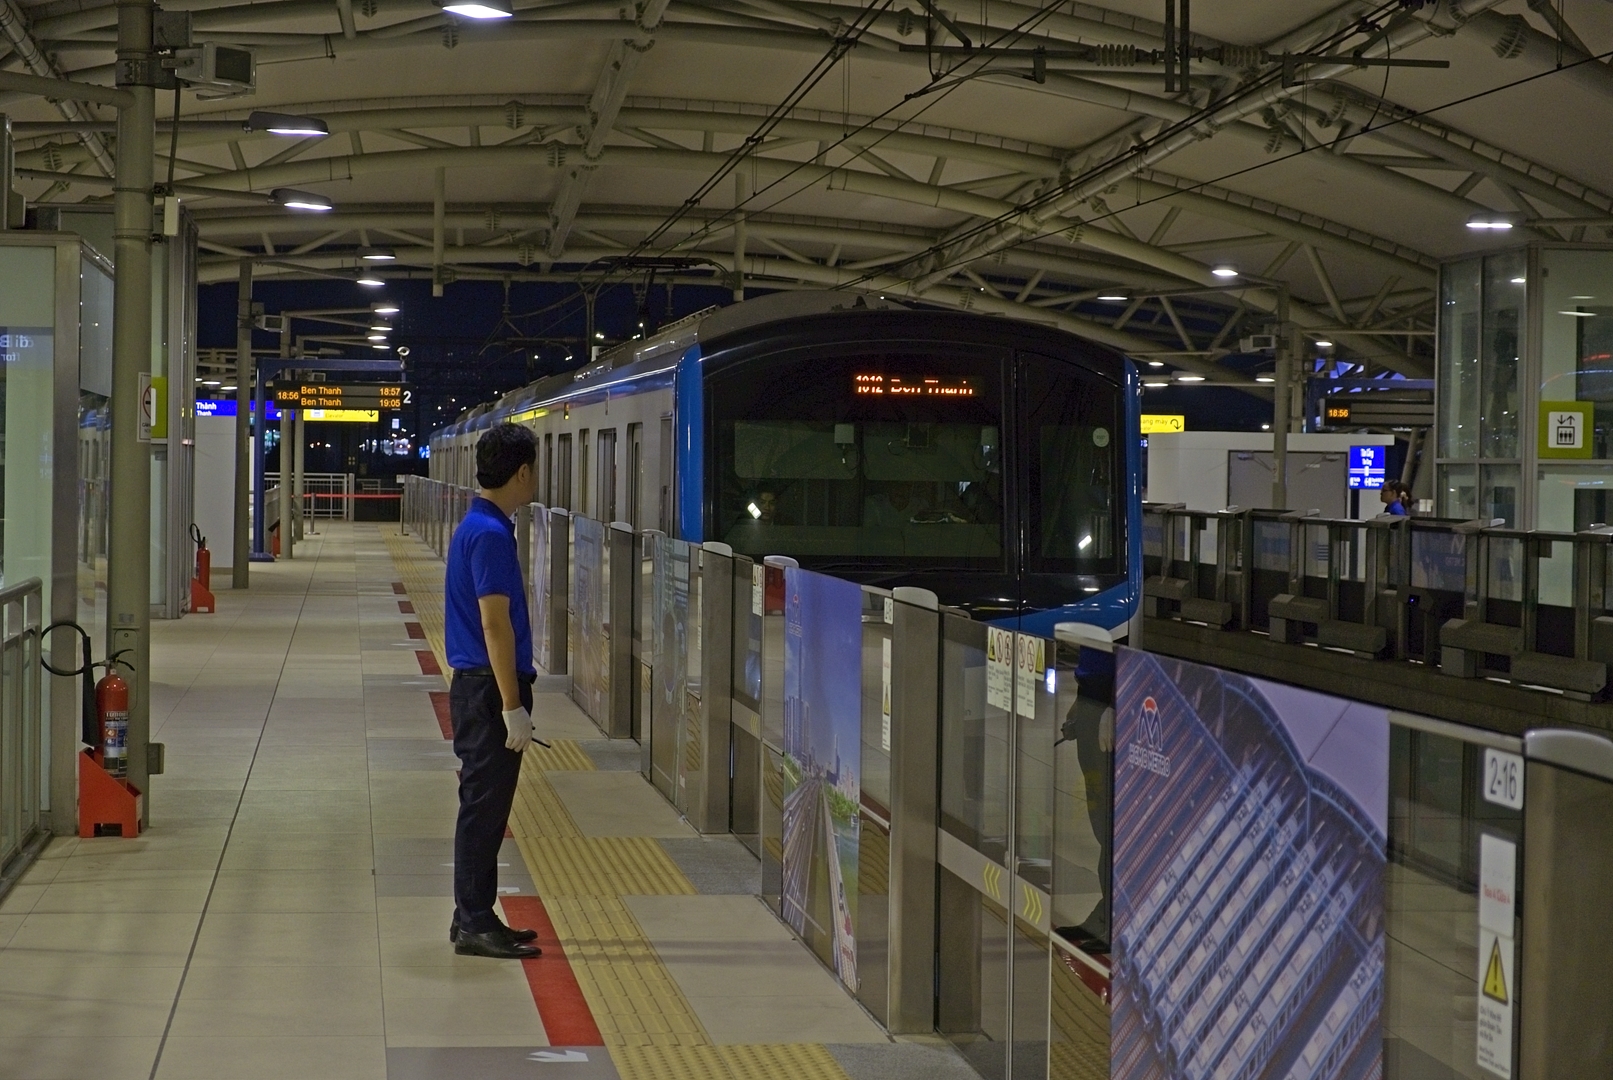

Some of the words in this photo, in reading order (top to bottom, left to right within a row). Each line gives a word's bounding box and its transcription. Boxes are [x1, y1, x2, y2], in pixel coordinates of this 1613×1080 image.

[277, 391, 299, 400] 18:56
[301, 386, 317, 395] Ben
[319, 386, 342, 395] Thanh
[380, 387, 401, 396] 18:57
[301, 397, 317, 406] Ben
[319, 397, 342, 406] Thanh
[380, 399, 401, 408] 19:05
[403, 391, 412, 404] 2
[1329, 409, 1348, 417] 18:56
[1490, 757, 1517, 801] 2-16
